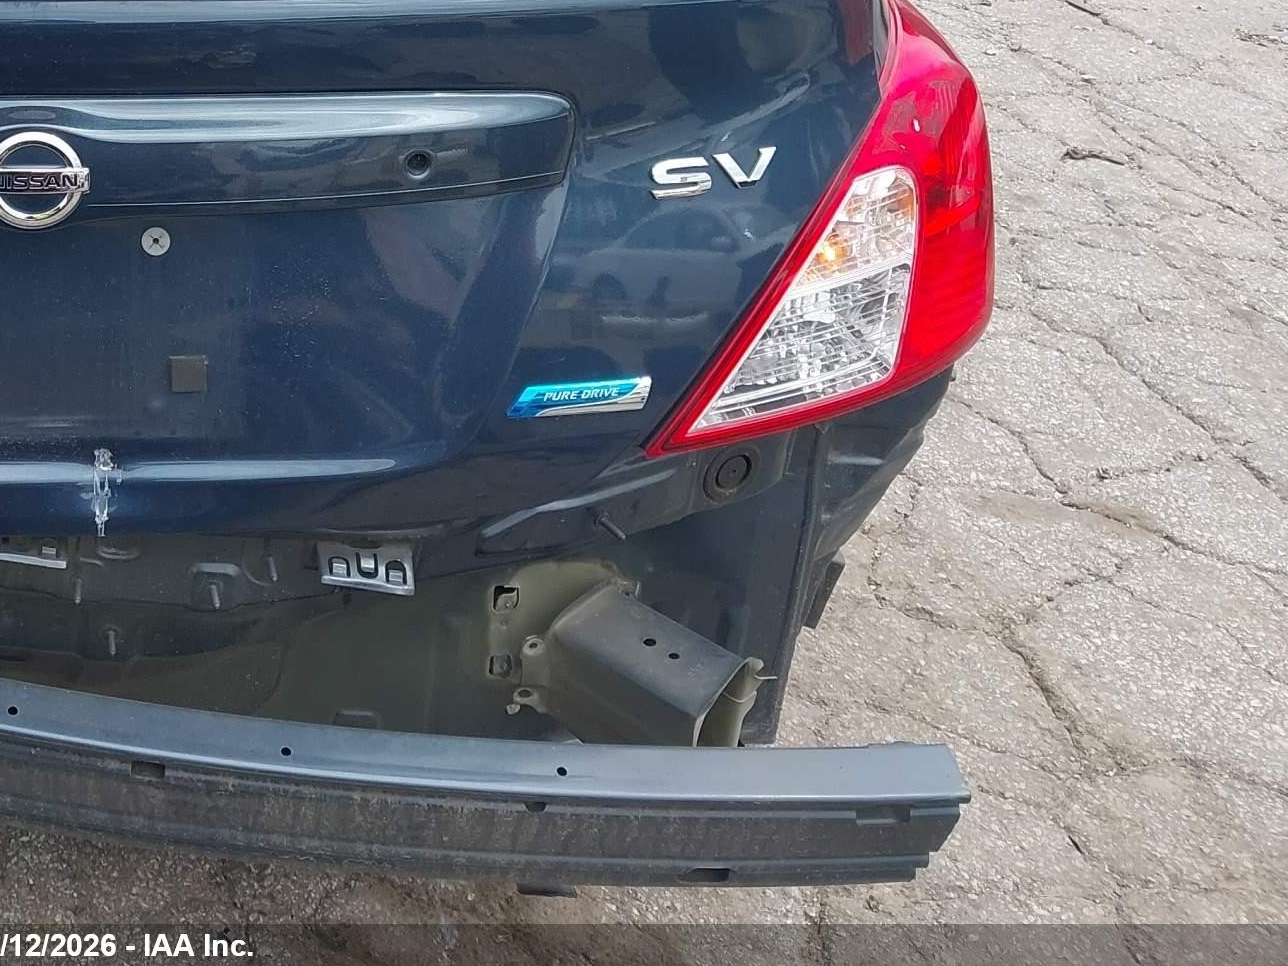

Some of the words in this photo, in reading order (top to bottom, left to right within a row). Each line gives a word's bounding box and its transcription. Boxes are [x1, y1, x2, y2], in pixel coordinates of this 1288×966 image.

[649, 146, 777, 199] SV
[544, 391, 579, 401] PURE
[581, 387, 619, 399] DRIVE
